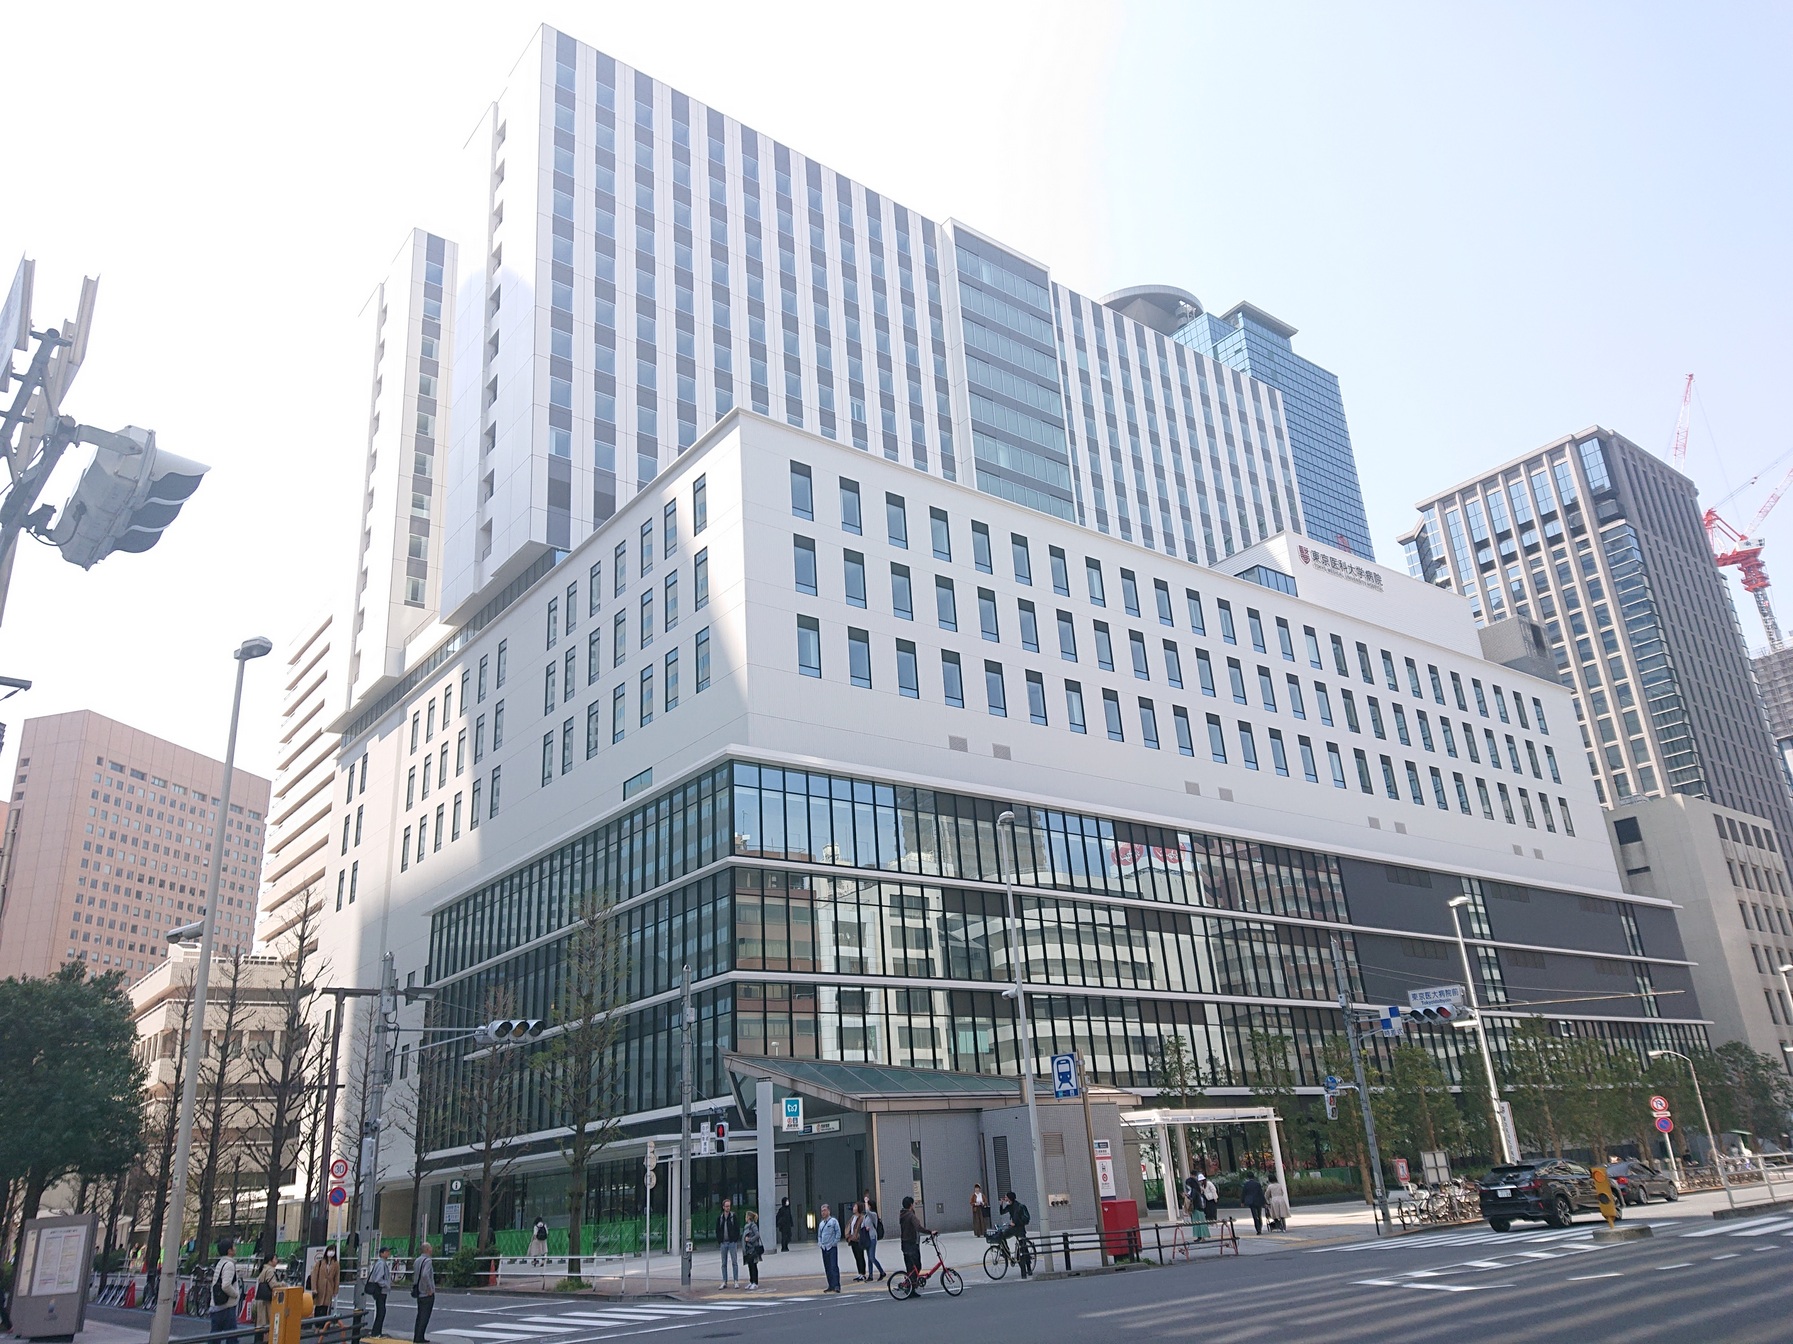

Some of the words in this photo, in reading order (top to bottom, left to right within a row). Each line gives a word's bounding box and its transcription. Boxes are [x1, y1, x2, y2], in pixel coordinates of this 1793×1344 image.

[1311, 550, 1383, 586] 東京医科大学病院
[1411, 988, 1459, 1001] 東京医大病院前
[334, 1164, 344, 1174] 30
